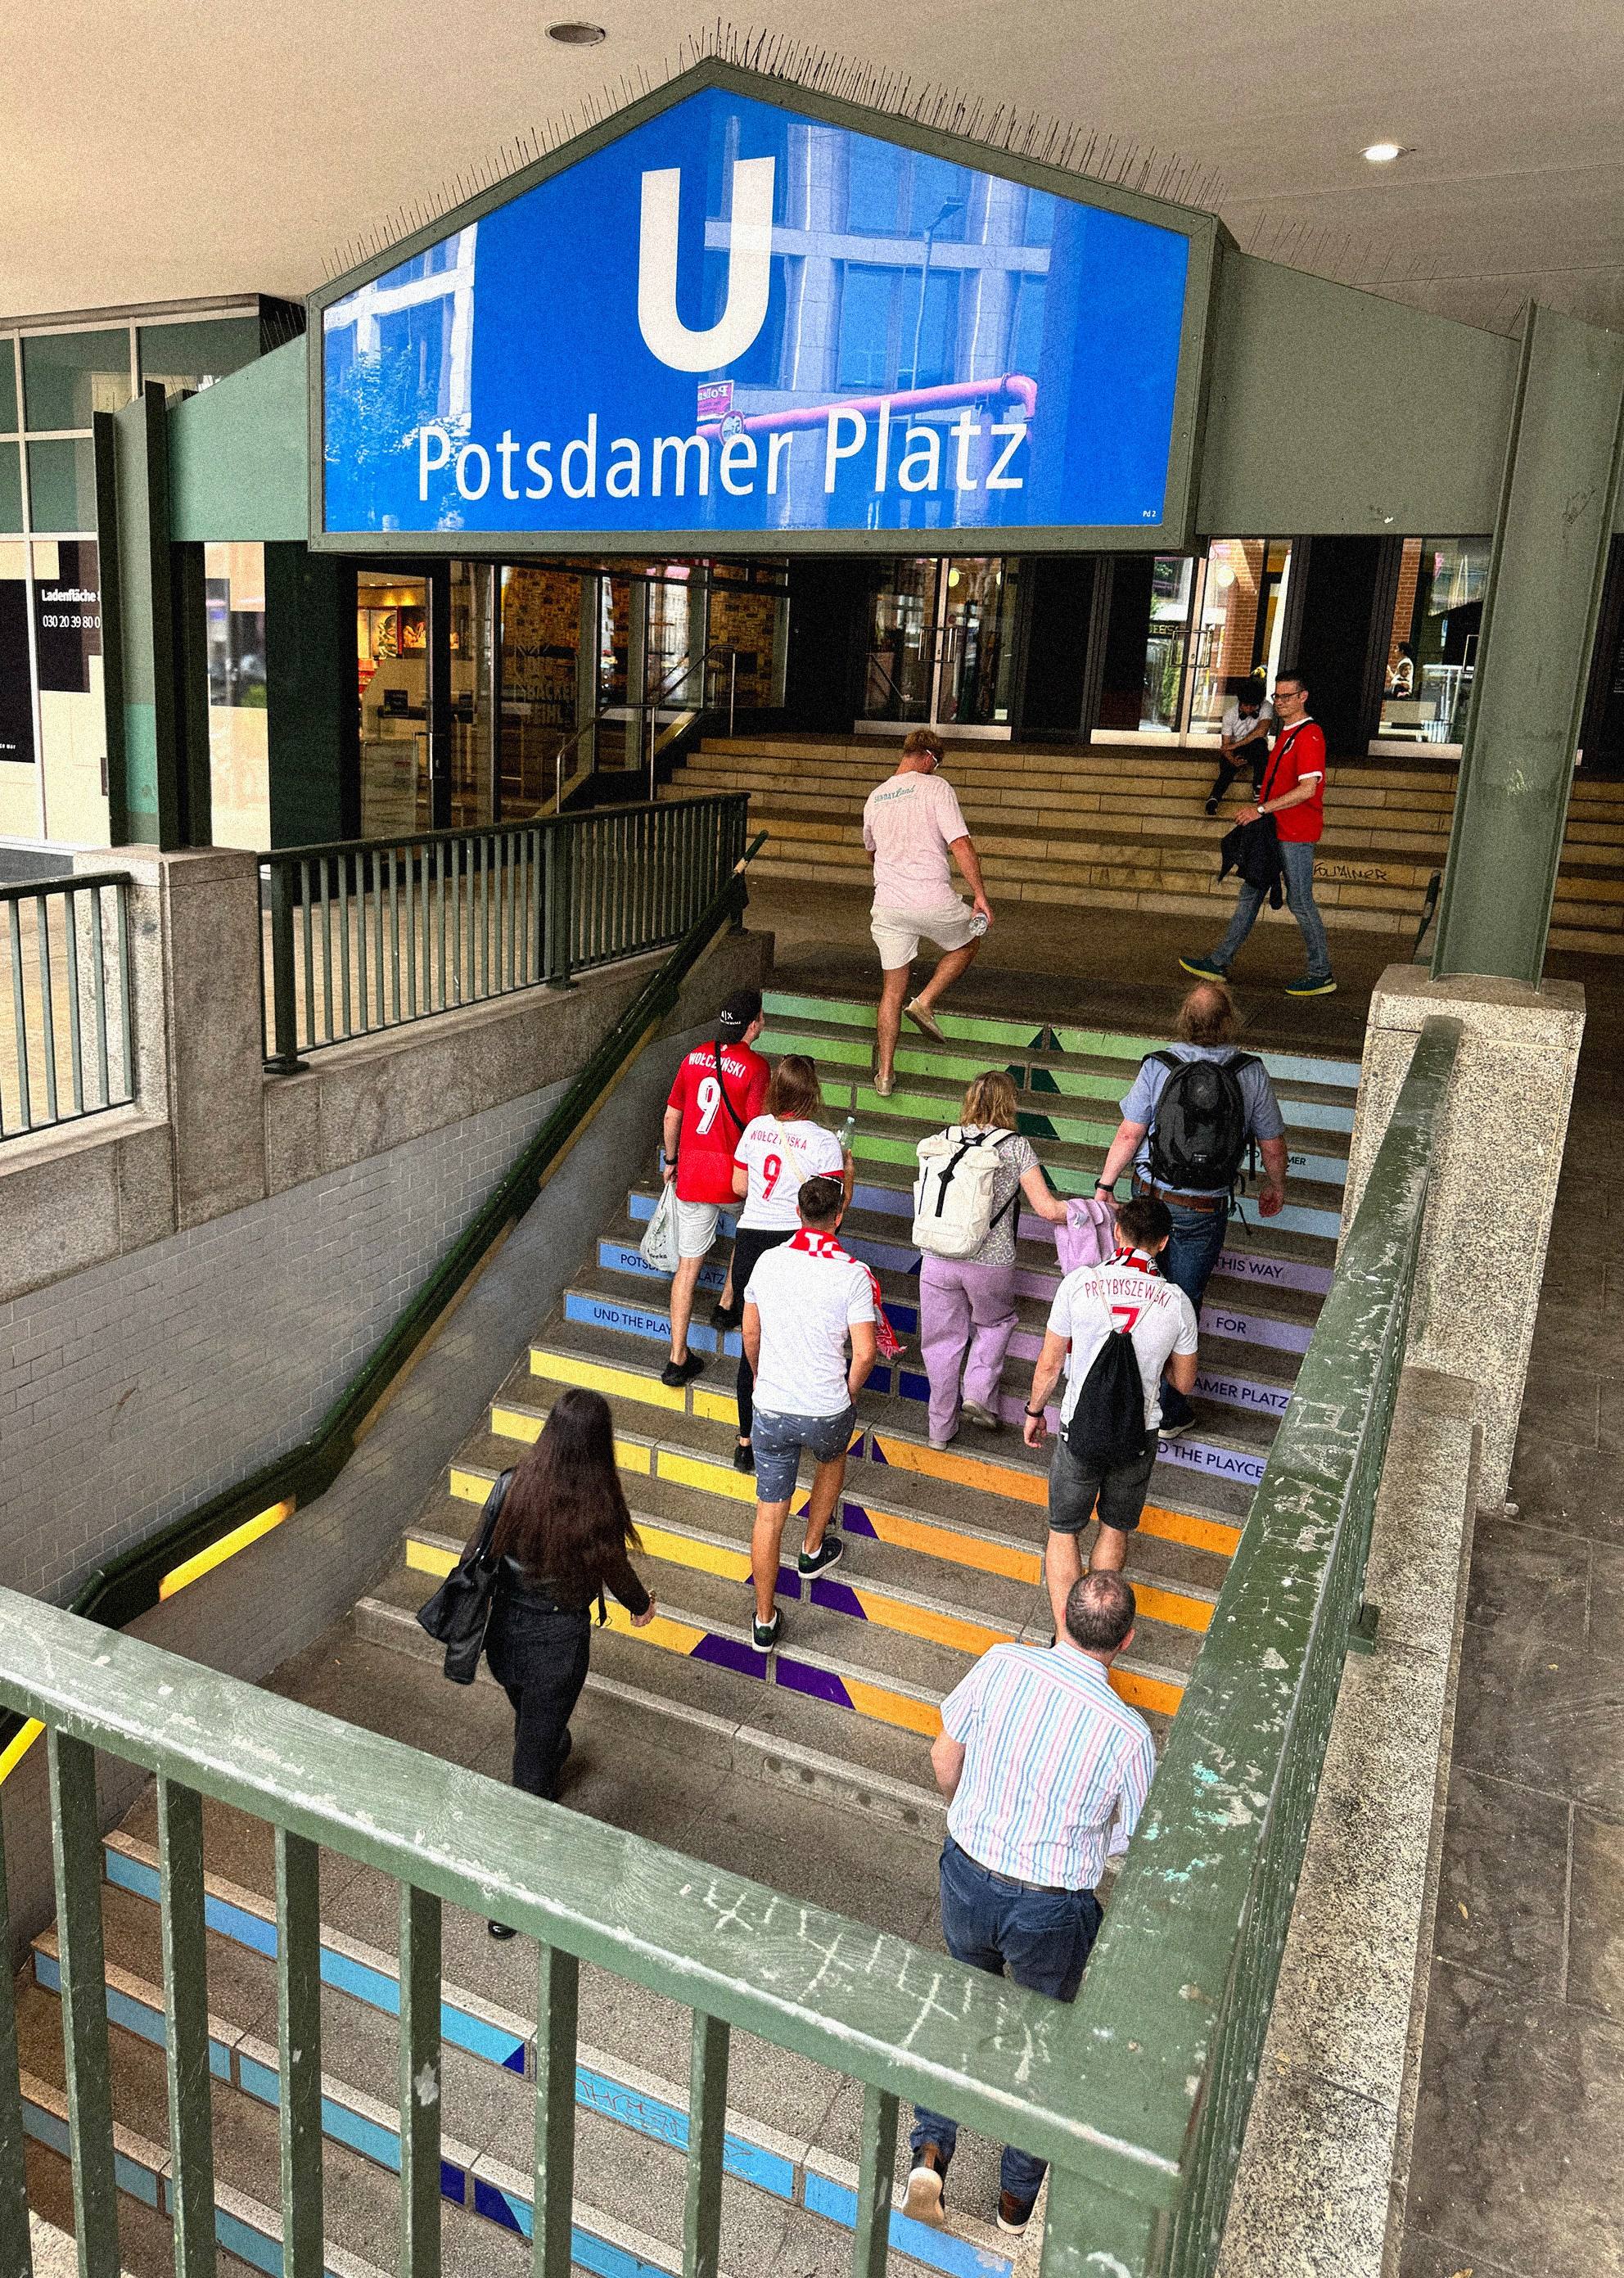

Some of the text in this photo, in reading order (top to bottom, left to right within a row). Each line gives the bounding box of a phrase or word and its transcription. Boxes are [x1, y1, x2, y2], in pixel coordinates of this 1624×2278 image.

[637, 156, 777, 373] U
[417, 399, 1028, 502] Potsdamer Platz
[42, 589, 97, 602] Ladenfläche
[43, 615, 58, 627] 030
[59, 616, 70, 627] 20
[70, 616, 82, 628] 39
[83, 616, 93, 628] 80
[696, 1076, 721, 1135] 9
[762, 1153, 783, 1202] 9
[1249, 1262, 1283, 1279] WAY
[593, 1307, 672, 1335] UND THE PLAY
[1111, 1306, 1141, 1334] 7
[1216, 1317, 1247, 1334] FOR
[1241, 1387, 1289, 1410] PLATZ
[1172, 1444, 1202, 1463] THE
[1207, 1453, 1265, 1478] PLAYCE
